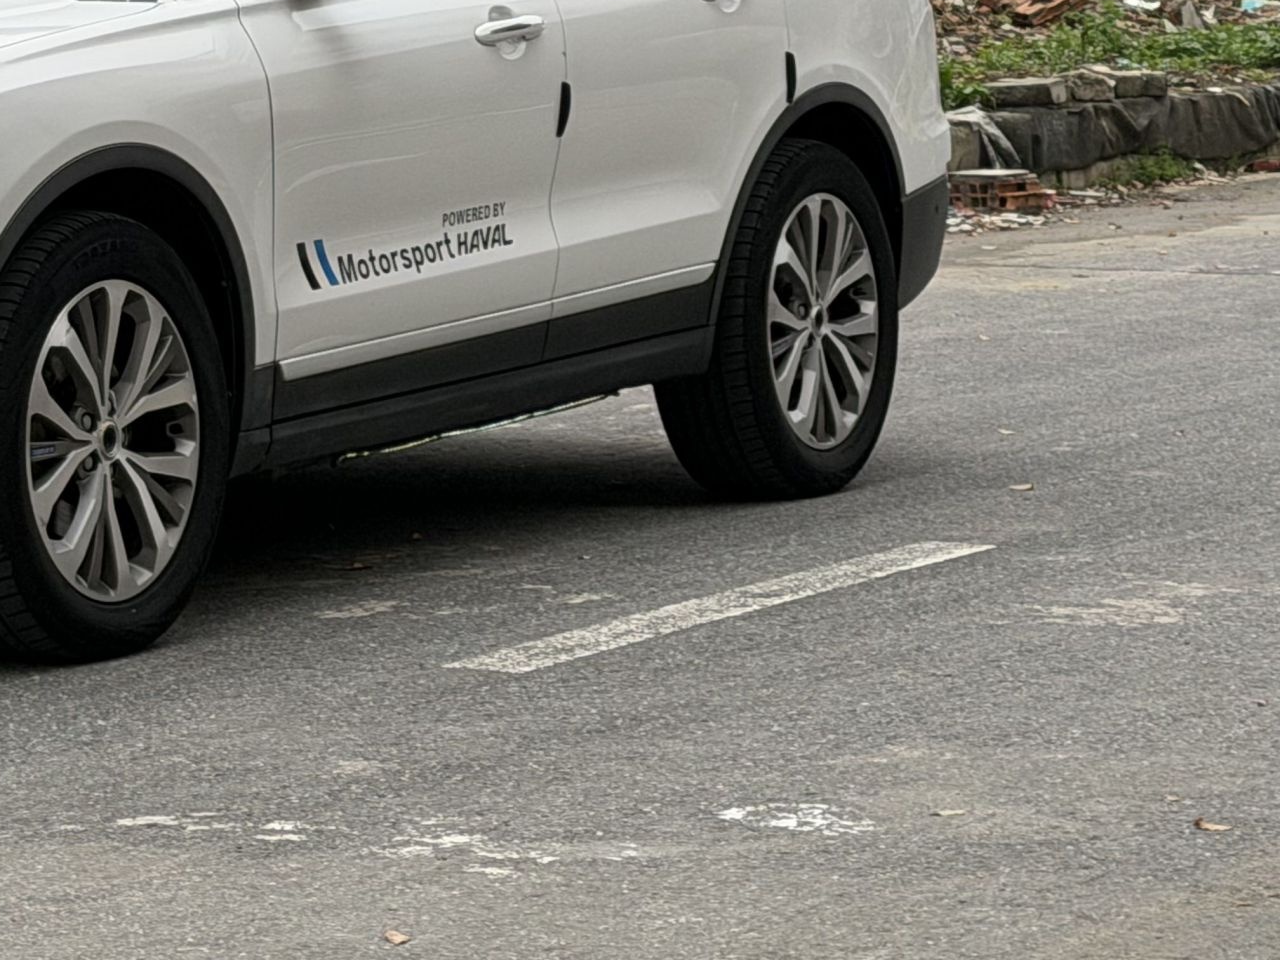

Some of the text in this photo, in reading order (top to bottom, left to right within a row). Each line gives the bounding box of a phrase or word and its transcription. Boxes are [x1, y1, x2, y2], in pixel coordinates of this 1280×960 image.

[442, 201, 506, 228] POWERED BY
[337, 223, 514, 284] Motorsport HAVAL
